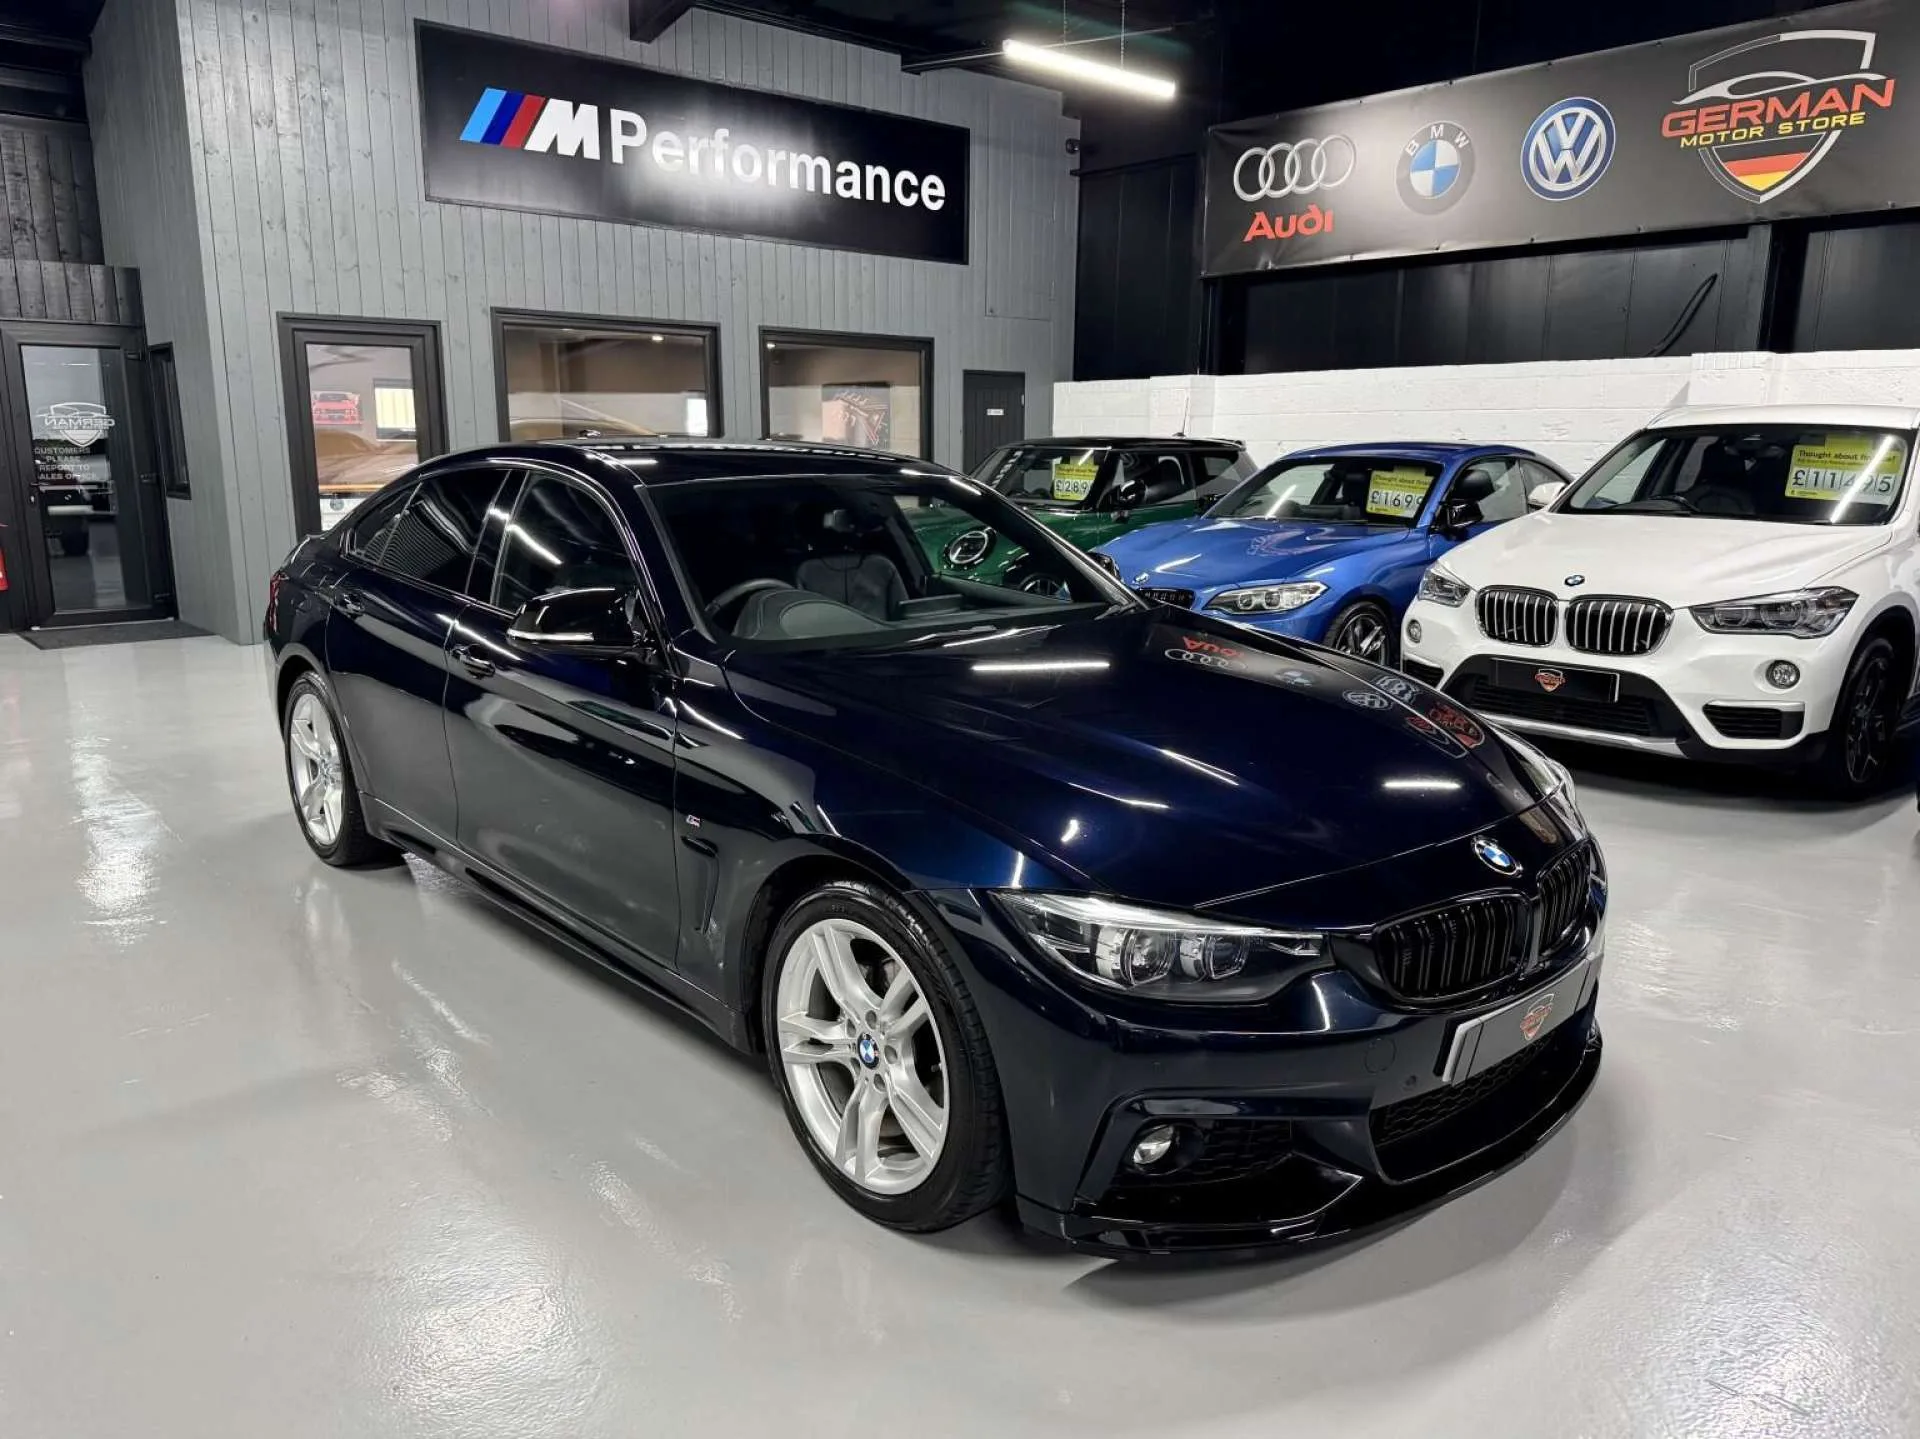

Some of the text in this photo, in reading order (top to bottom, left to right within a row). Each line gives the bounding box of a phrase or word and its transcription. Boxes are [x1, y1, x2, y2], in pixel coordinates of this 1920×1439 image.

[1661, 78, 1896, 138] GERMAN
[1405, 123, 1470, 157] BMW
[1680, 111, 1866, 148] MOTOR STORE
[524, 98, 946, 211] M Performance
[1243, 203, 1334, 242] Audi
